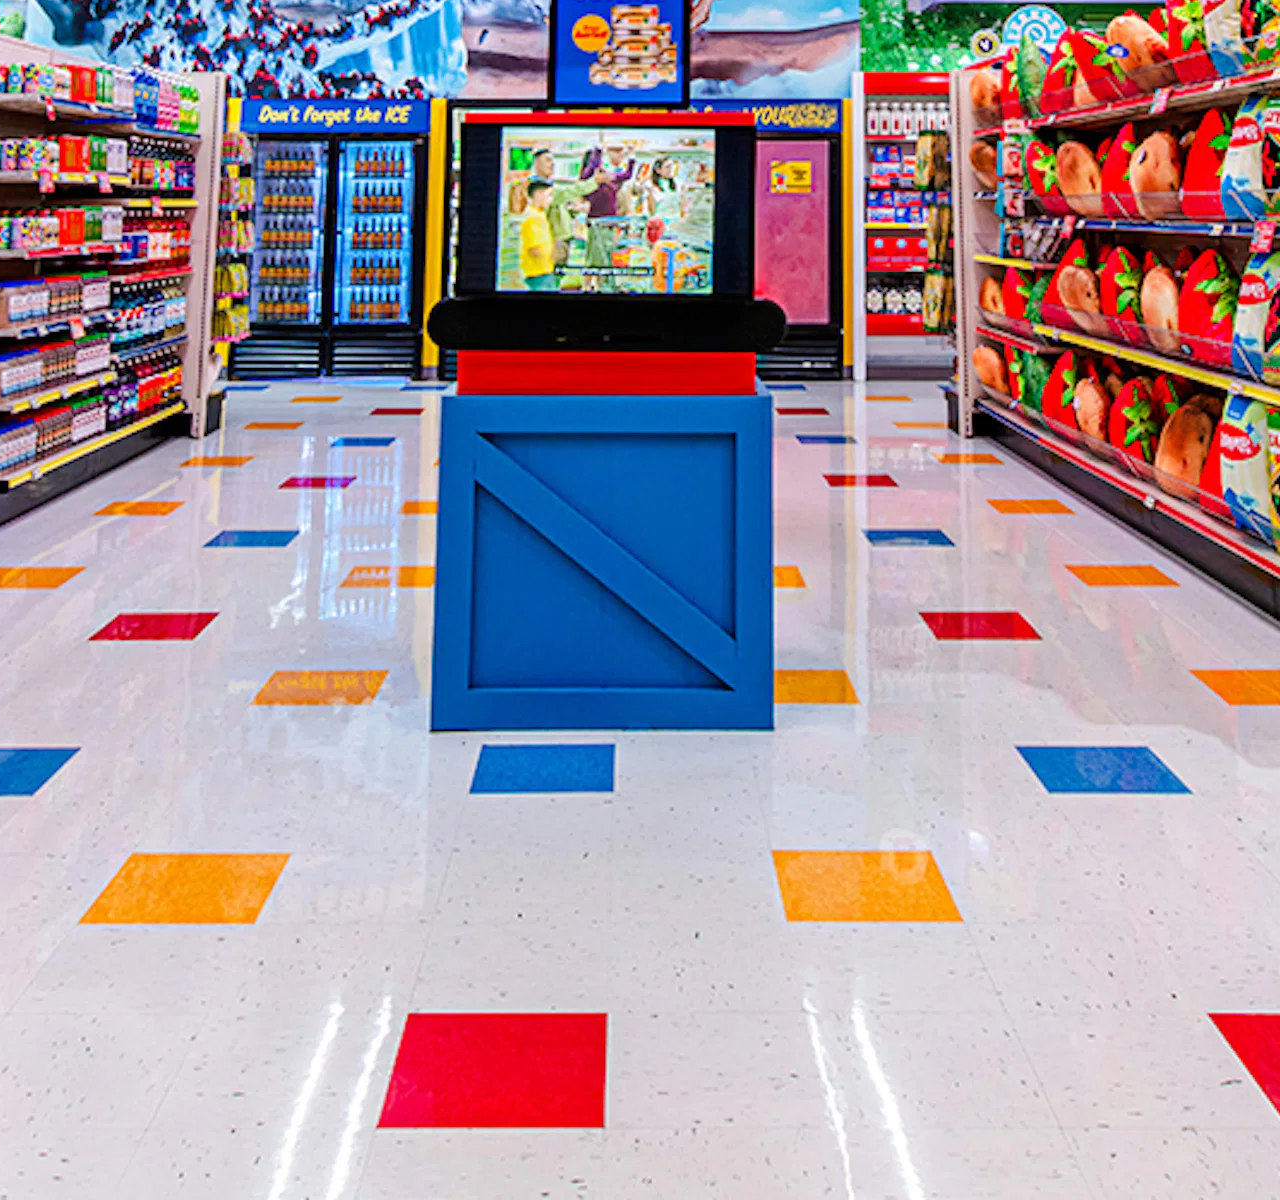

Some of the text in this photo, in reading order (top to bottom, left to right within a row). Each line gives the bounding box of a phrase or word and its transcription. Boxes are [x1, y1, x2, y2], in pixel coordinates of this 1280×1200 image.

[258, 103, 412, 126] Don't forget the ICE
